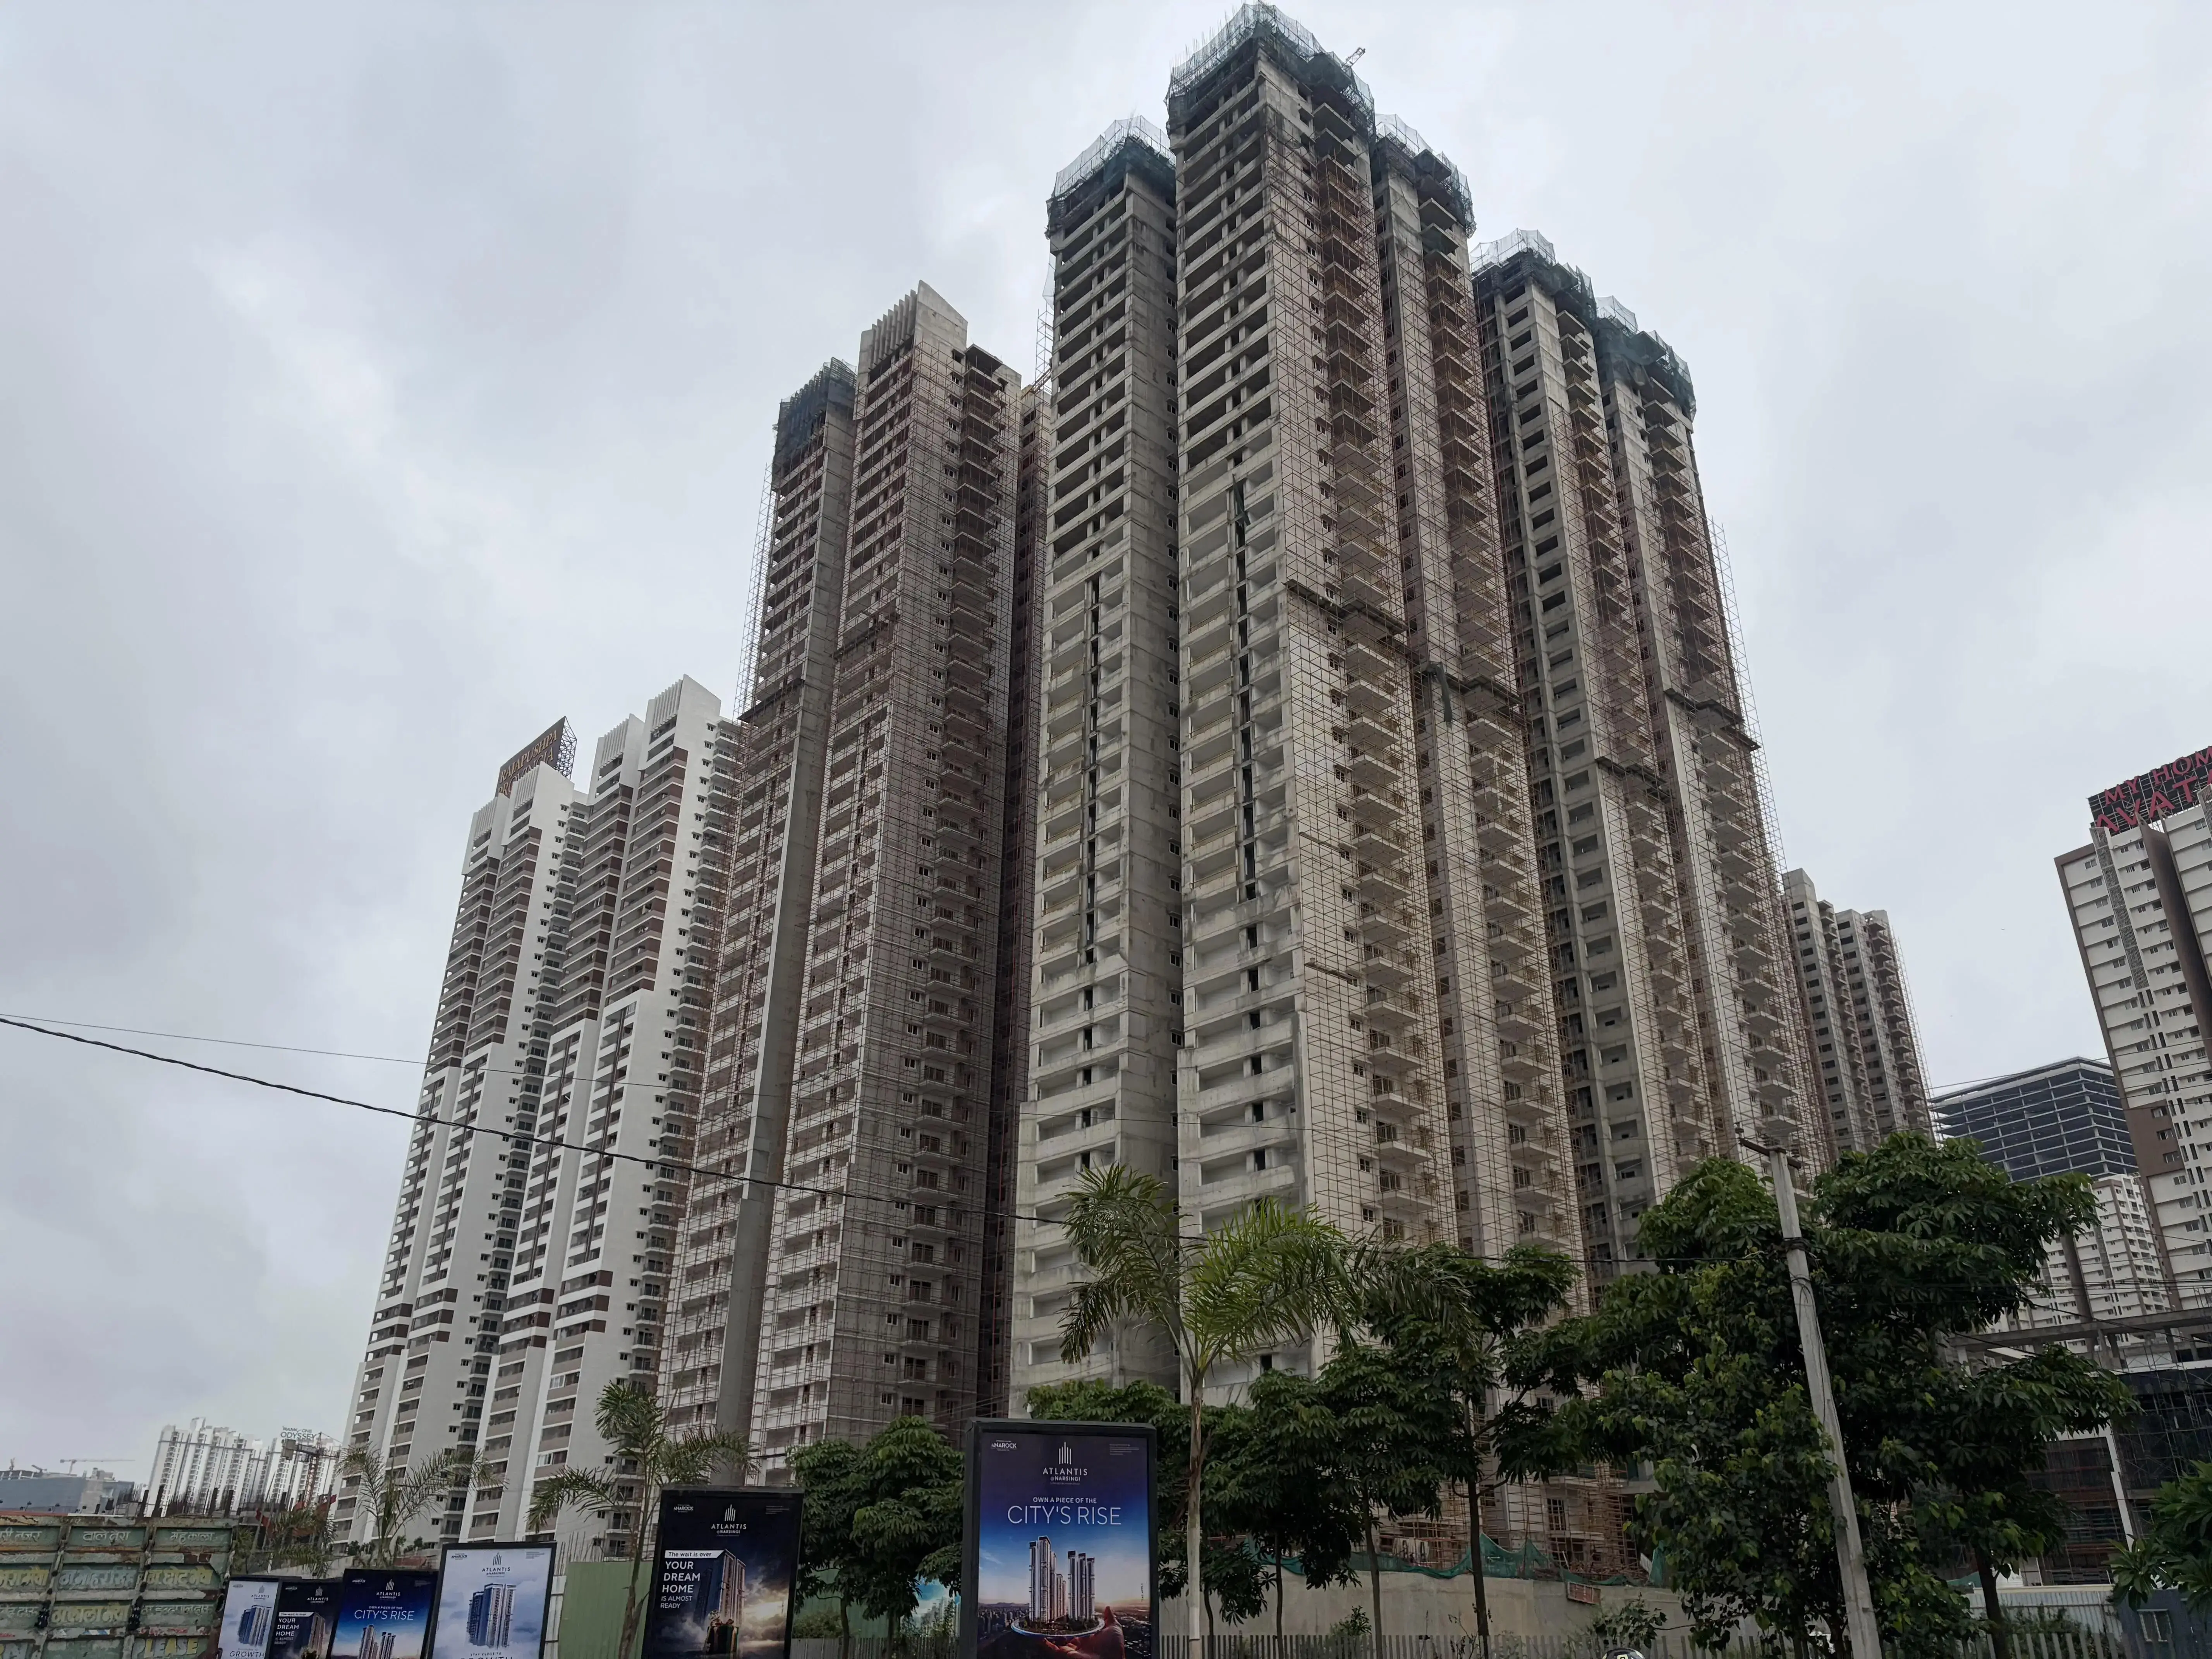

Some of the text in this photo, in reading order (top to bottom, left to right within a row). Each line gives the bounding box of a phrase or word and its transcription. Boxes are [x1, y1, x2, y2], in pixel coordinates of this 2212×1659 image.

[500, 730, 557, 784] RAJAPUSHPA
[2104, 776, 2140, 805] MY
[2096, 769, 2212, 833] AVAT
[1042, 1467, 1088, 1476] ATLANTIS
[1008, 1505, 1121, 1525] CITY'S RISE
[665, 1561, 694, 1570] YOUR
[663, 1573, 700, 1581] DREAM
[662, 1585, 694, 1593] HOME
[354, 1610, 415, 1620] CITY'S RISE
[132, 1637, 198, 1659] PLEASE
